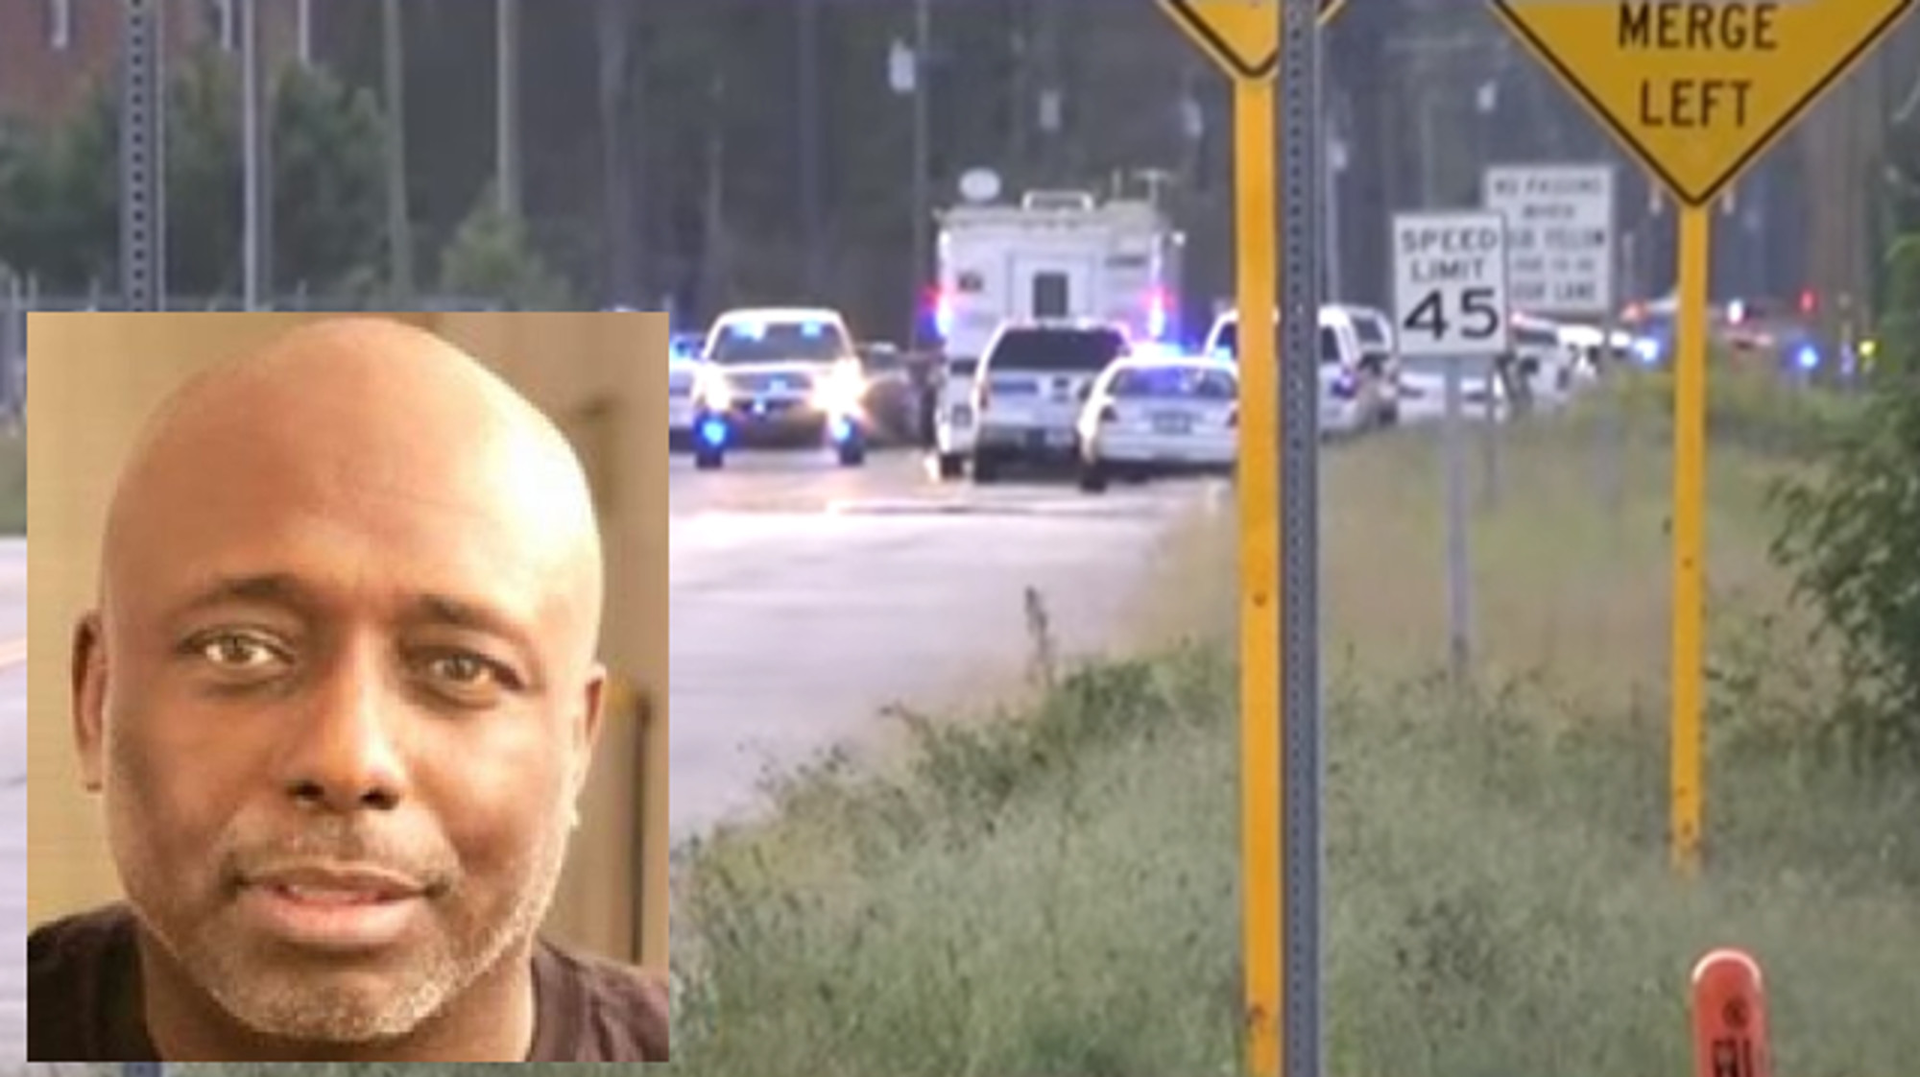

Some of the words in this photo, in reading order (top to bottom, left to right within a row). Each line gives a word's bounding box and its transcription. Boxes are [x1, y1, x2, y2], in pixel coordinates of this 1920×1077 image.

[1618, 3, 1777, 50] MERGE
[1640, 79, 1752, 127] LEFT
[1402, 229, 1497, 250] SPEED
[1411, 259, 1483, 281] LIMIT
[1404, 288, 1498, 340] 45
